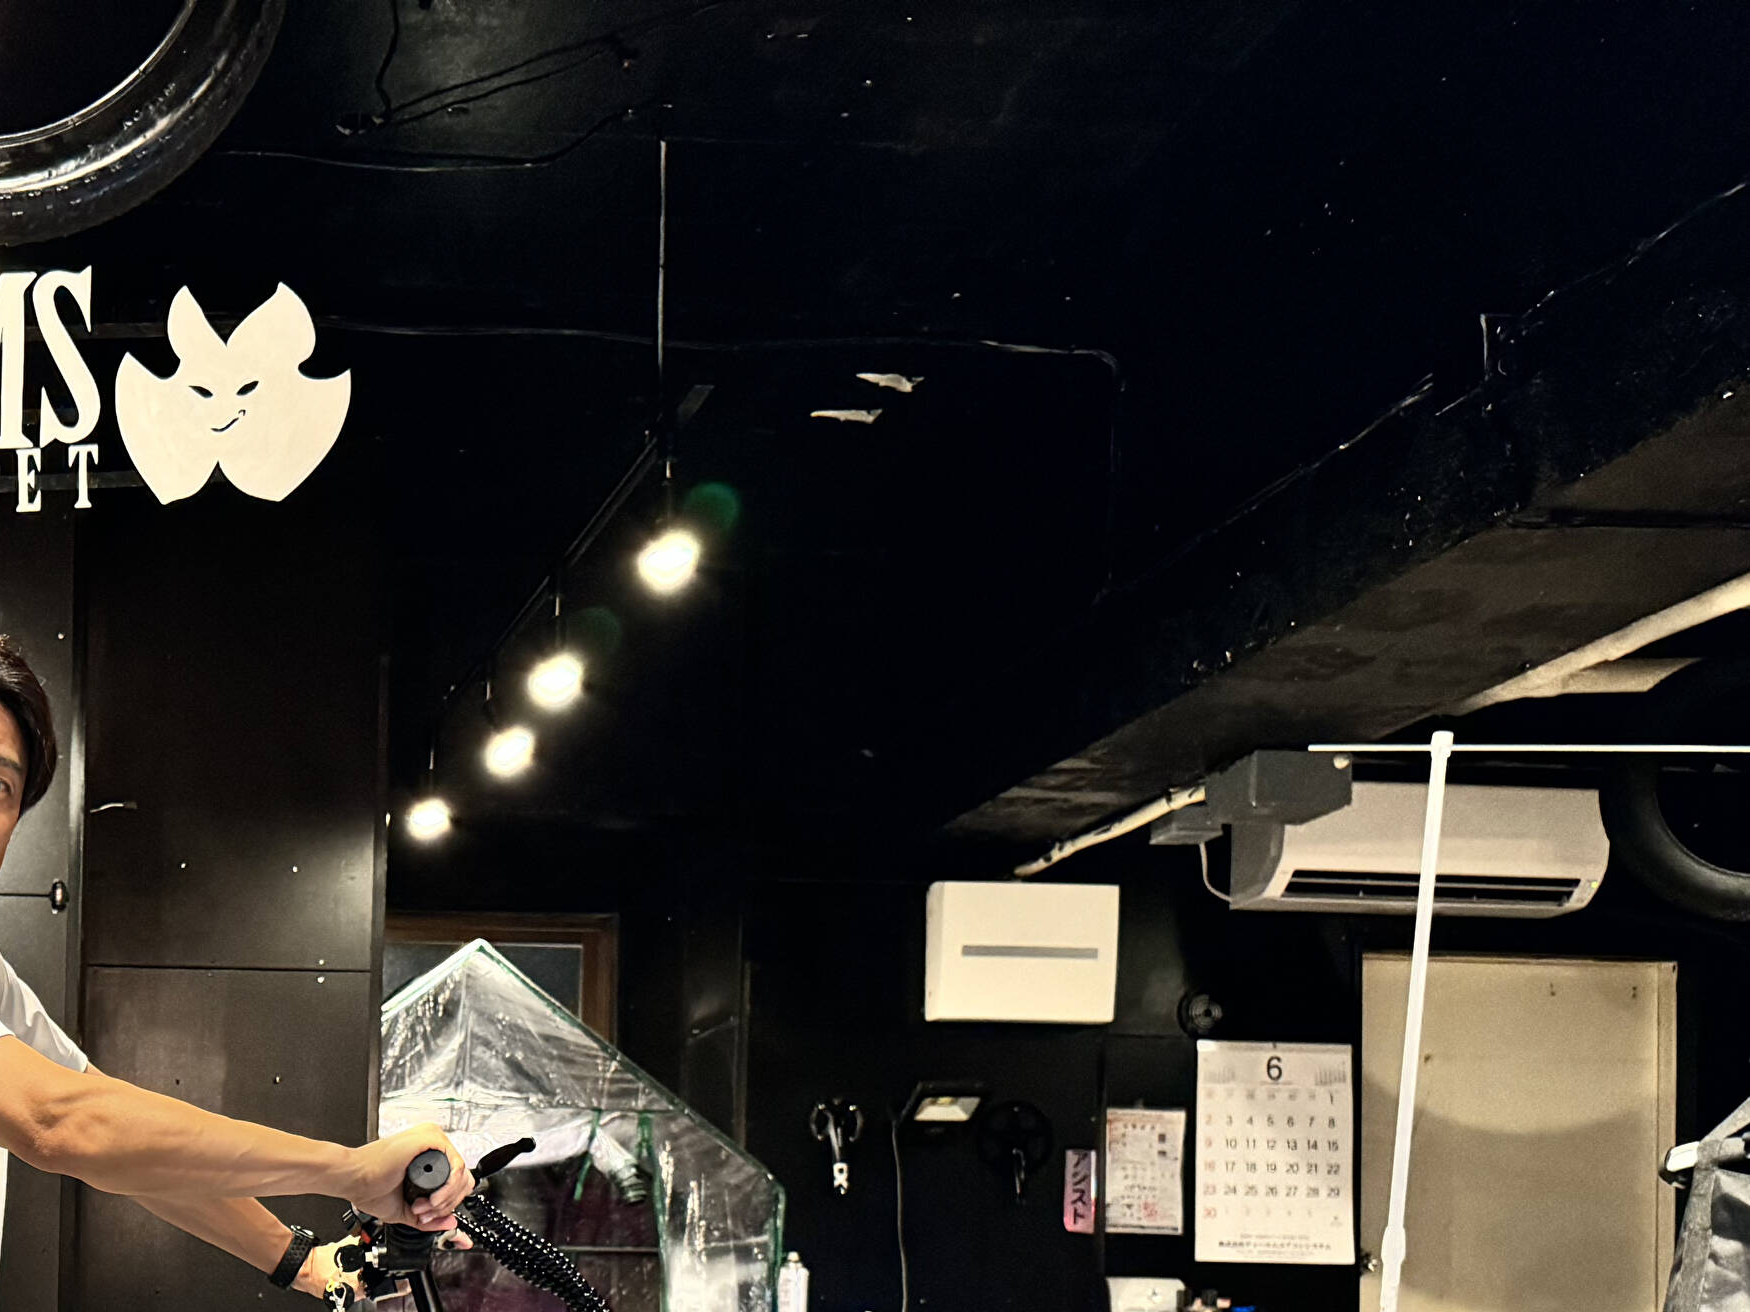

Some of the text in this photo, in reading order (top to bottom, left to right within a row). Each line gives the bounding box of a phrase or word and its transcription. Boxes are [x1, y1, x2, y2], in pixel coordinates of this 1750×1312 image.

[1266, 1056, 1282, 1081] 6
[1267, 1114, 1274, 1126] 5
[1287, 1116, 1294, 1127] 6
[1308, 1116, 1315, 1128] 7
[1328, 1117, 1336, 1128] 8
[1226, 1138, 1237, 1149] 10
[1246, 1139, 1256, 1148] 11
[1266, 1140, 1276, 1150] 12
[1286, 1139, 1298, 1150] 13
[1307, 1140, 1318, 1150] 14
[1328, 1140, 1338, 1151] 15
[1225, 1161, 1236, 1173] 17
[1246, 1162, 1256, 1173] 18
[1266, 1162, 1277, 1174] 19
[1286, 1162, 1299, 1174] 20
[1307, 1162, 1318, 1174] 21
[1327, 1163, 1340, 1175] 22
[1224, 1184, 1236, 1196] 24
[1244, 1185, 1258, 1196] 25
[1266, 1185, 1278, 1197] 26
[1286, 1186, 1298, 1197] 27
[1327, 1186, 1340, 1198] 29
